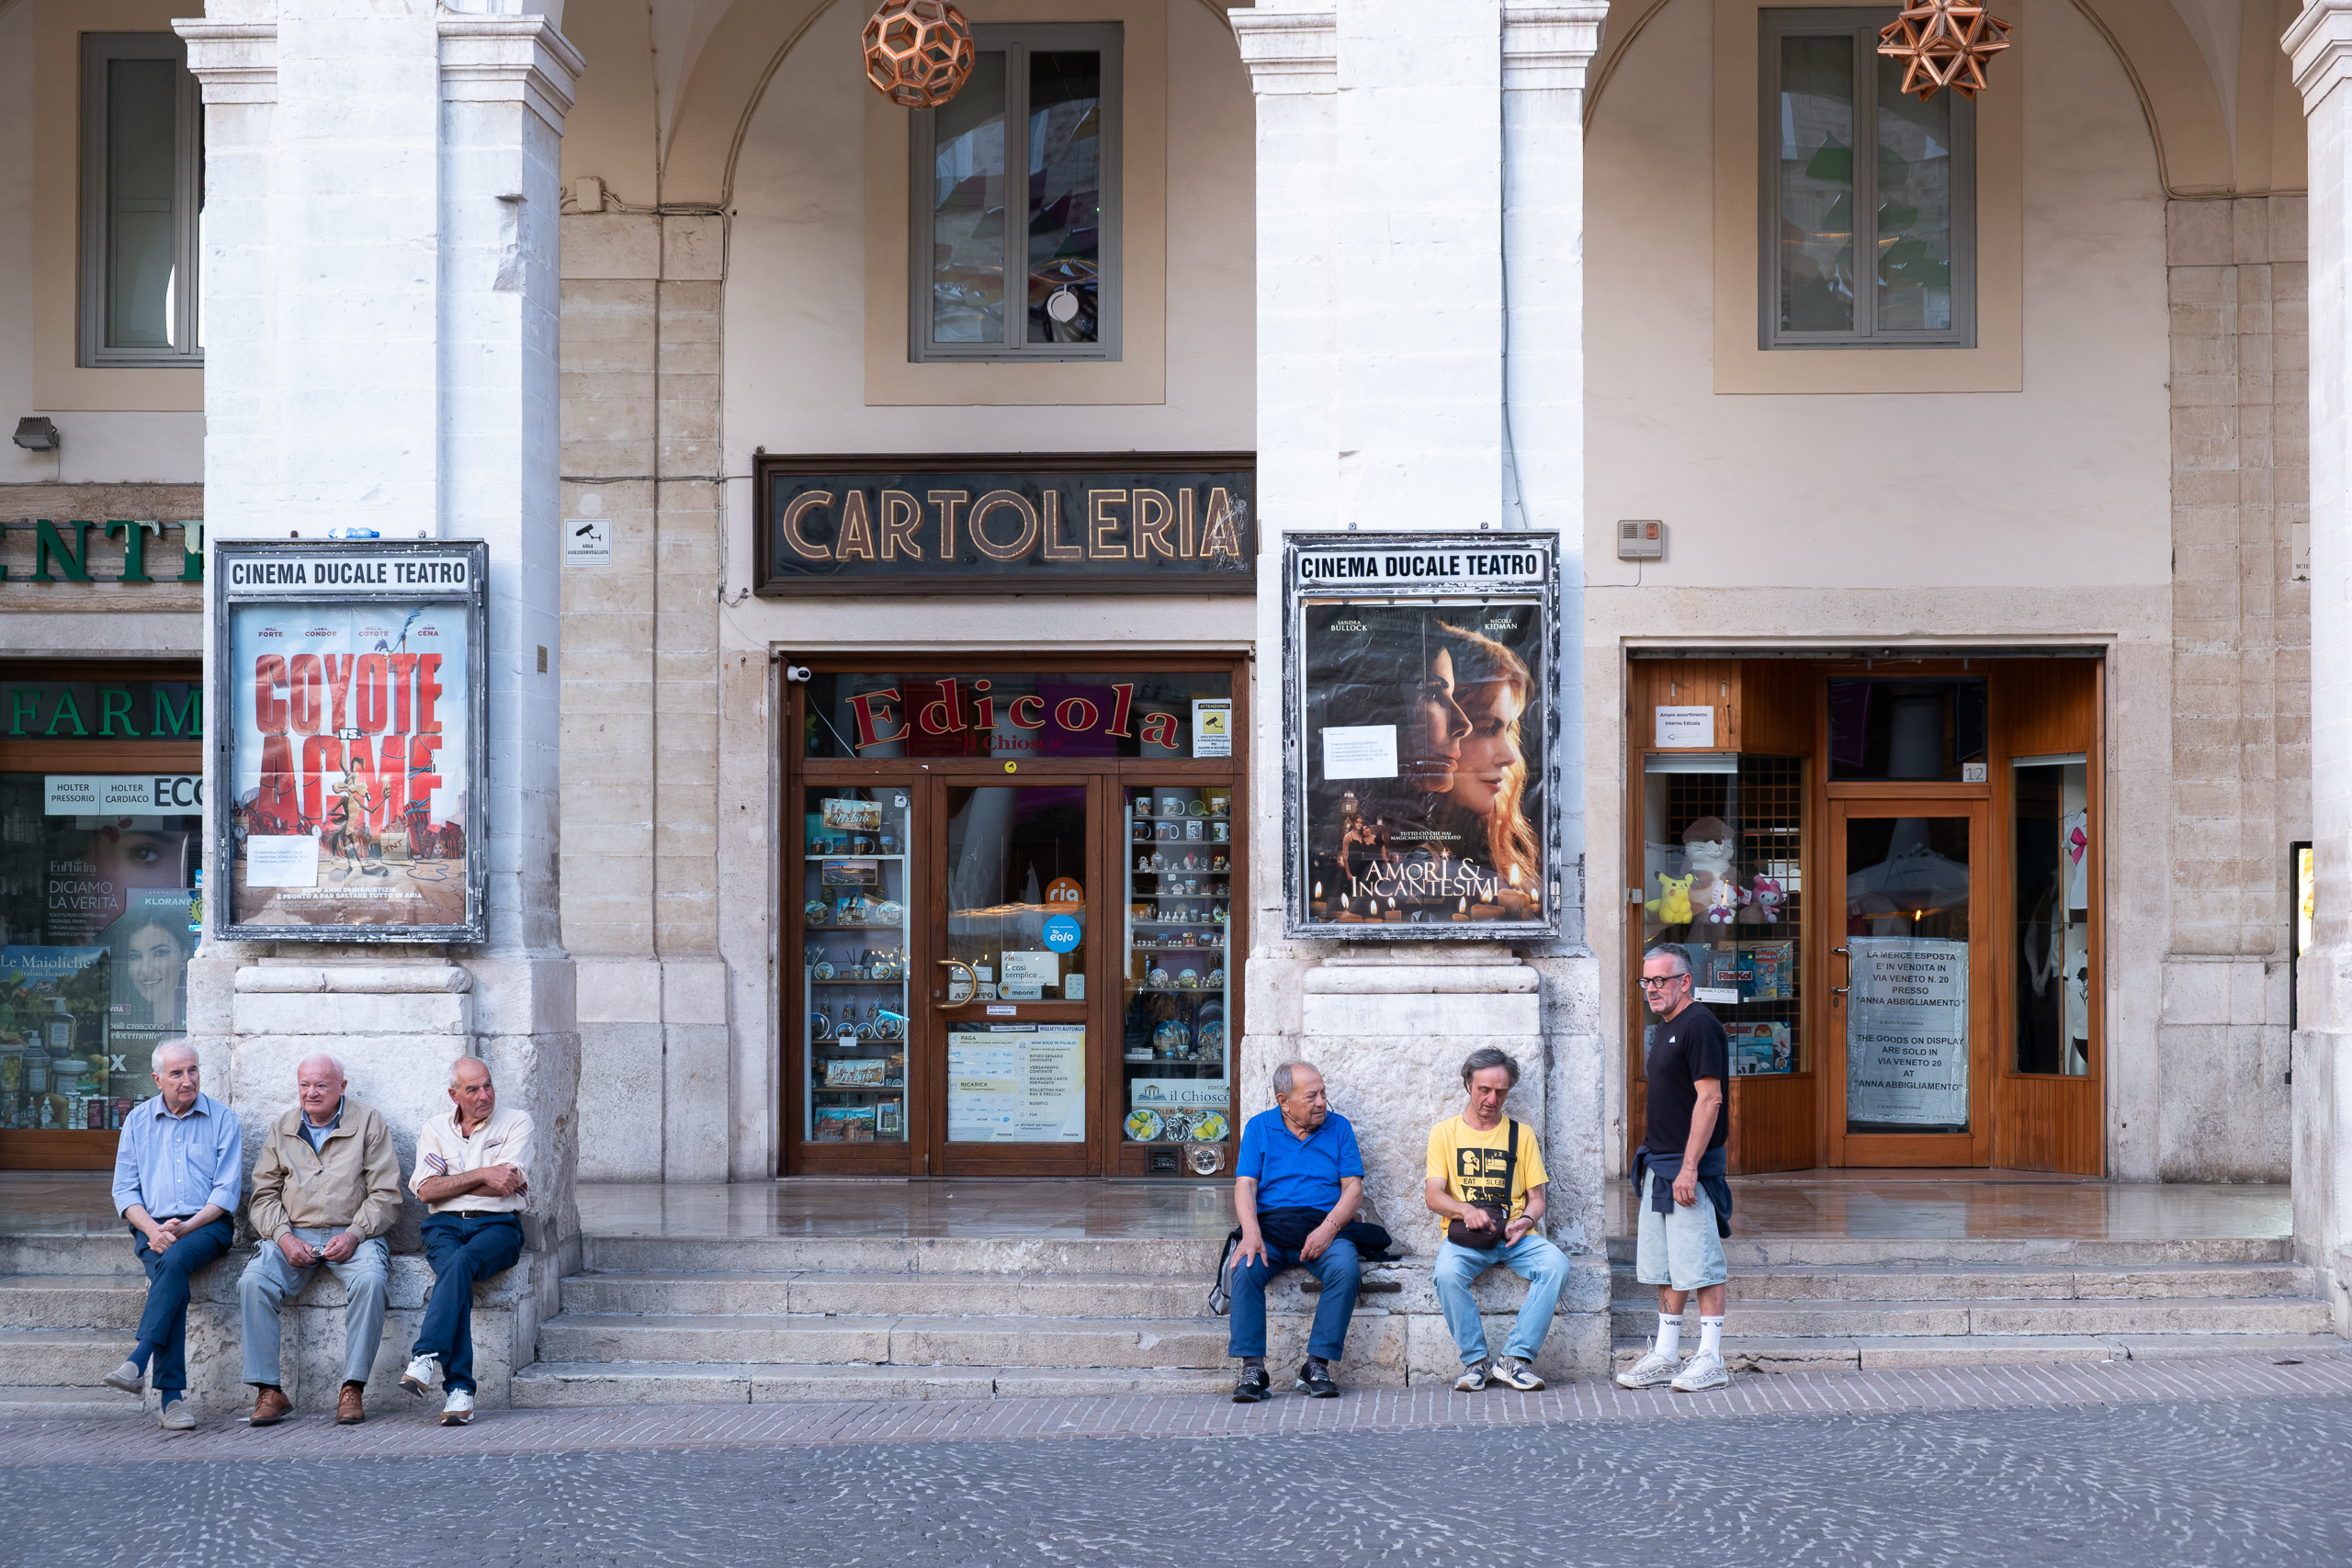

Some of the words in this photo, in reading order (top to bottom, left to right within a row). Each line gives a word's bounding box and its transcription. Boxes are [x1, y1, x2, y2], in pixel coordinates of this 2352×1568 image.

[783, 488, 1241, 563] CARTOLERIA
[232, 563, 307, 584] CINEMA
[314, 562, 388, 584] DUCALE
[394, 562, 465, 584] TEATRO
[1301, 557, 1378, 579] CINEMA
[1385, 555, 1461, 577] DUCALE
[1466, 554, 1538, 576] TEATRO
[255, 653, 442, 735] COYOTE
[8, 689, 203, 736] FARM
[845, 678, 1179, 750] Edicola
[340, 729, 361, 740] VS.
[1966, 768, 1984, 781] 12
[57, 784, 90, 792] HOLTER
[257, 735, 442, 834] ACME
[384, 839, 402, 852] TNT
[1365, 860, 1449, 881] AMORI
[1458, 858, 1485, 881] &
[50, 880, 112, 895] DICIAMO
[1049, 882, 1079, 902] ria
[1351, 876, 1498, 897] INCANTESIMI
[50, 897, 67, 908] LA
[70, 894, 119, 909] VERITÀ
[1050, 932, 1074, 943] eolo
[0, 954, 17, 967] Le
[22, 955, 91, 969] Maioliche
[1915, 953, 1956, 961] ESPOSTA
[1877, 1035, 1909, 1044] GOODS
[1894, 1058, 1929, 1066] VENETO
[1170, 1090, 1176, 1101] il
